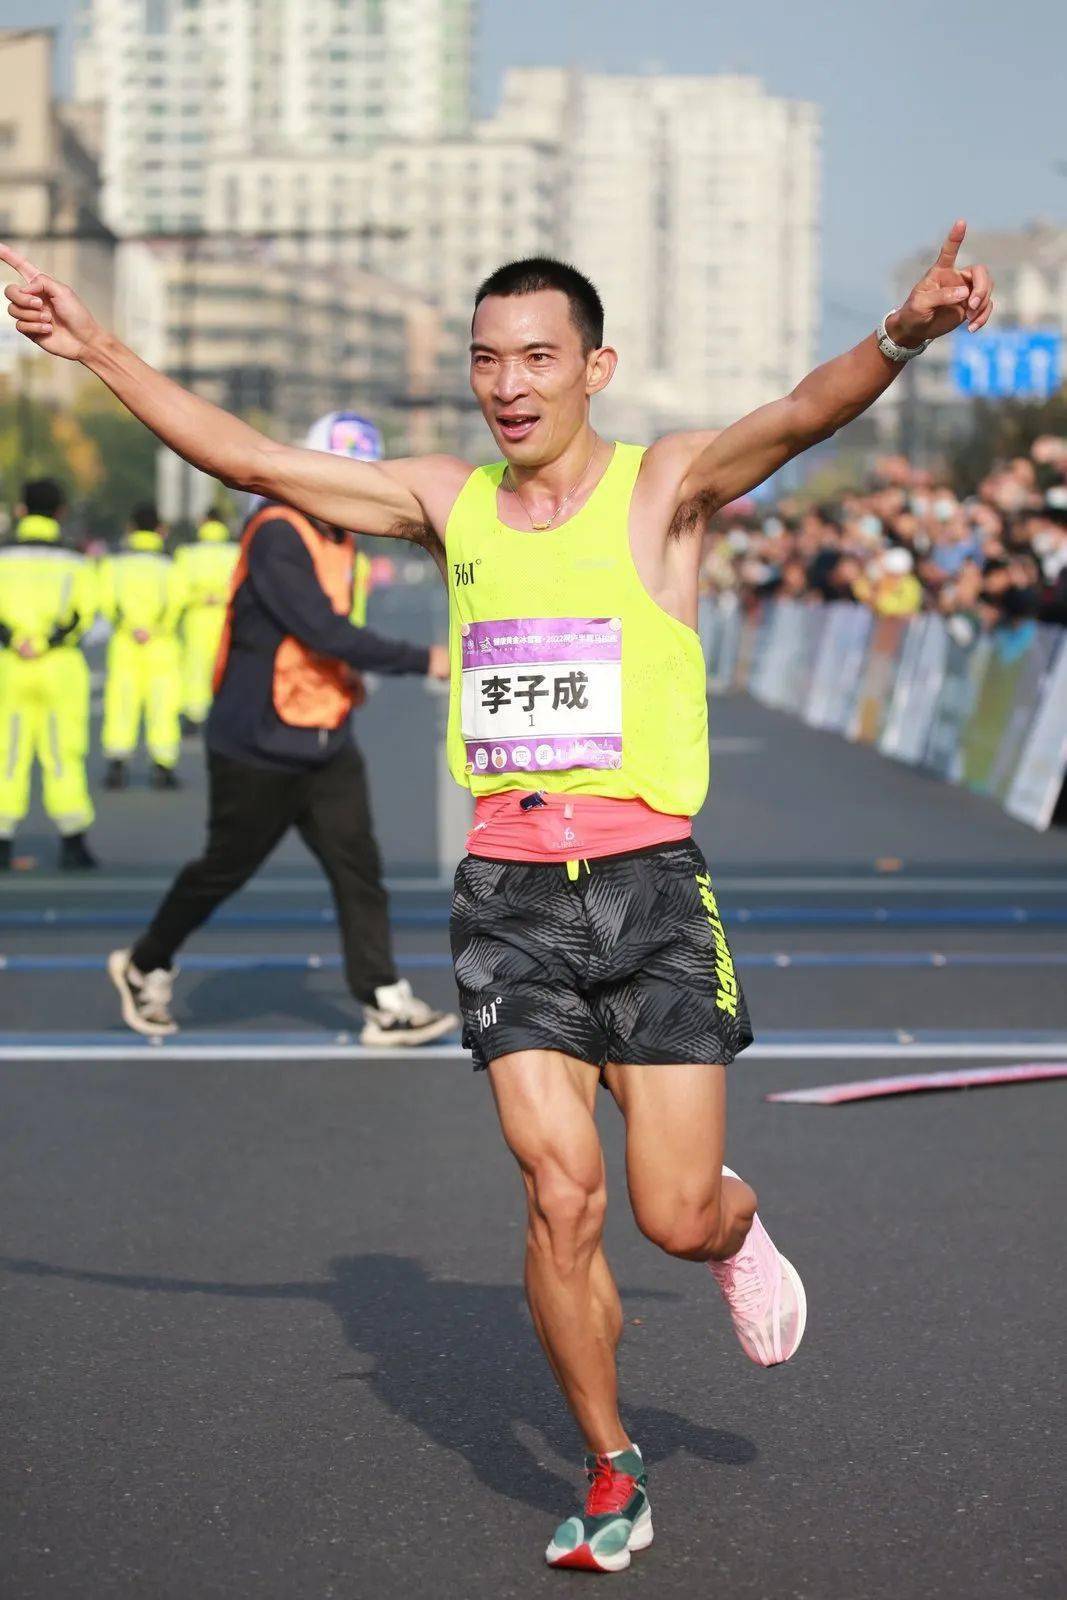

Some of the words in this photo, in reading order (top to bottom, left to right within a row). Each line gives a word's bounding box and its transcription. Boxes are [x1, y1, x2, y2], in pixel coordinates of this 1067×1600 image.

[481, 671, 589, 714] 李子成
[528, 714, 536, 727] 1
